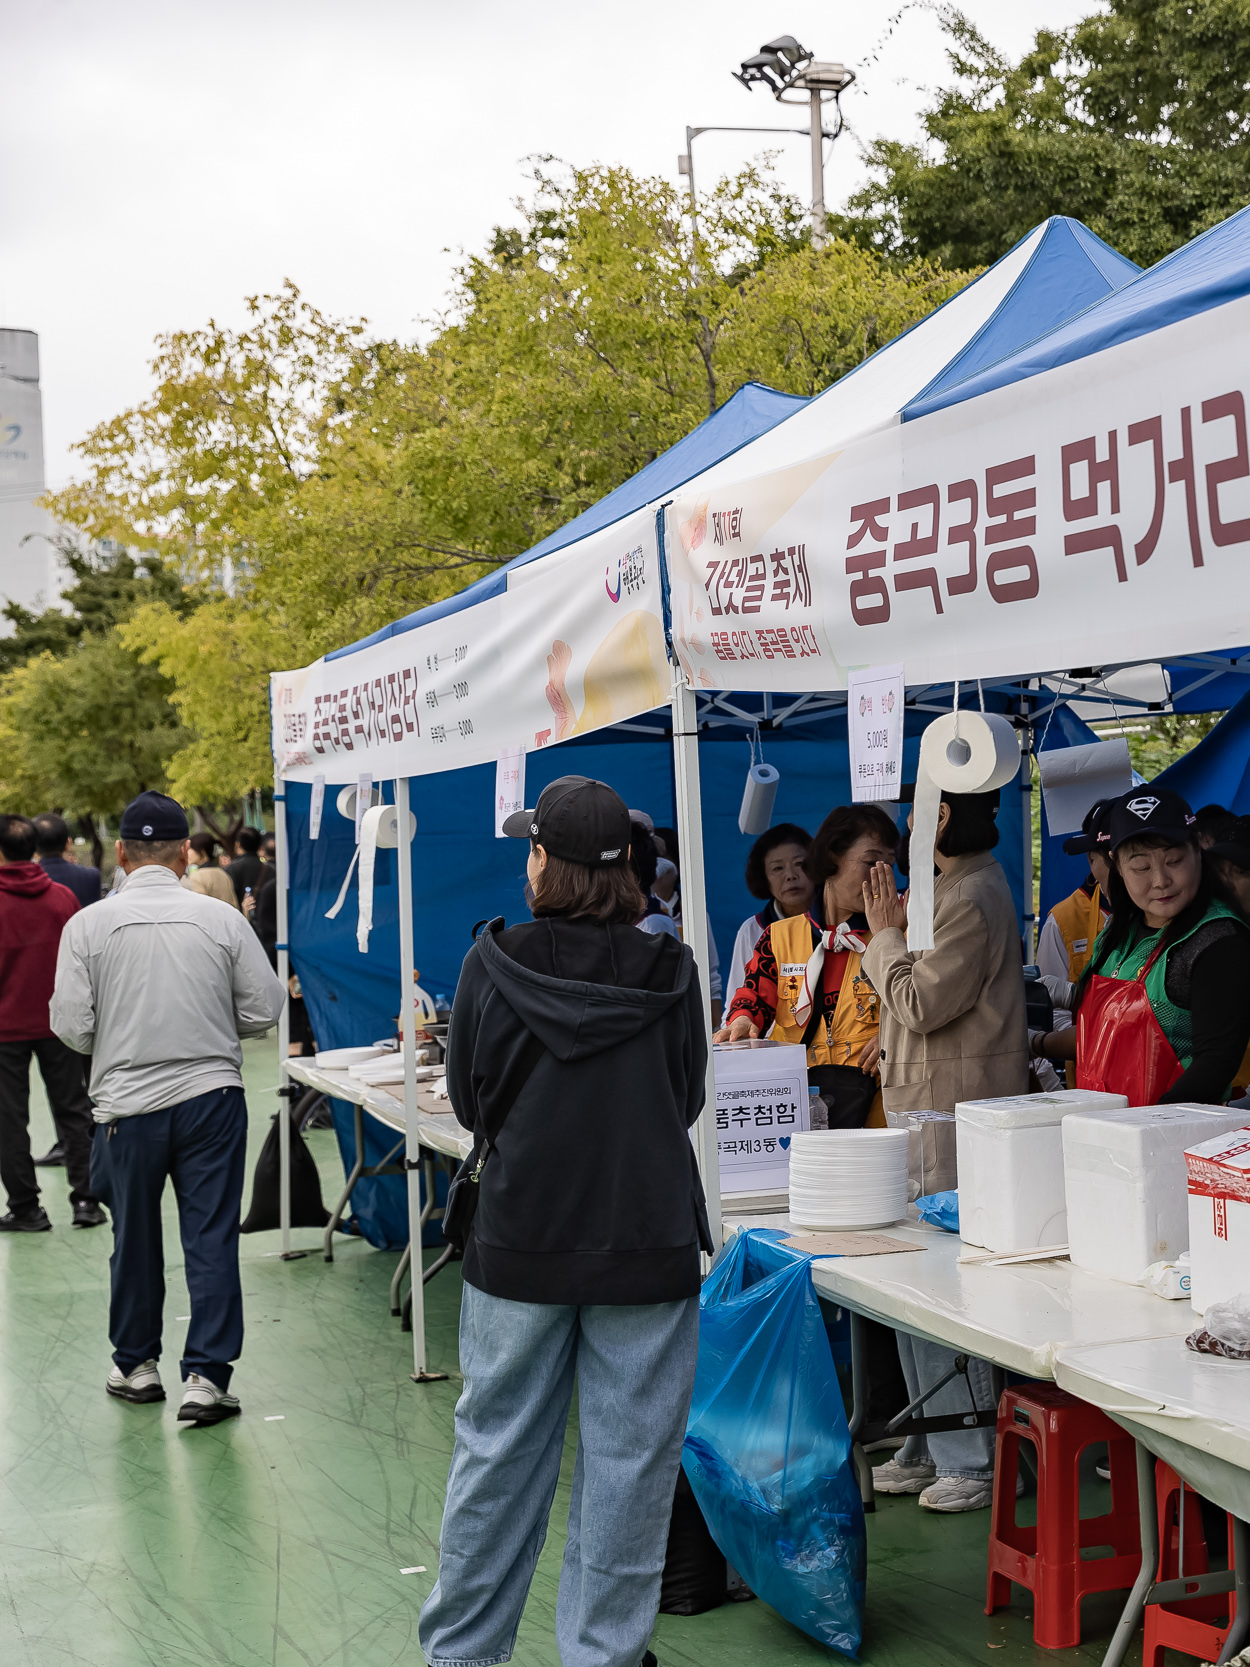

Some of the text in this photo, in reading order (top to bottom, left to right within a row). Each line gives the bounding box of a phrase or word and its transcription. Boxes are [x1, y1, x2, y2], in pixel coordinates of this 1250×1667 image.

[712, 507, 743, 546] 제11회
[845, 454, 1040, 626] 중곡3동
[704, 553, 767, 616] 간뎃골
[769, 544, 812, 610] 축제
[710, 631, 738, 661] 꿈을
[755, 627, 797, 660] 중곡을
[790, 624, 822, 658] 잇다
[313, 688, 354, 754] 중곡3동
[350, 666, 421, 748] 먹거리장터
[717, 1137, 777, 1156] 곡제3동
